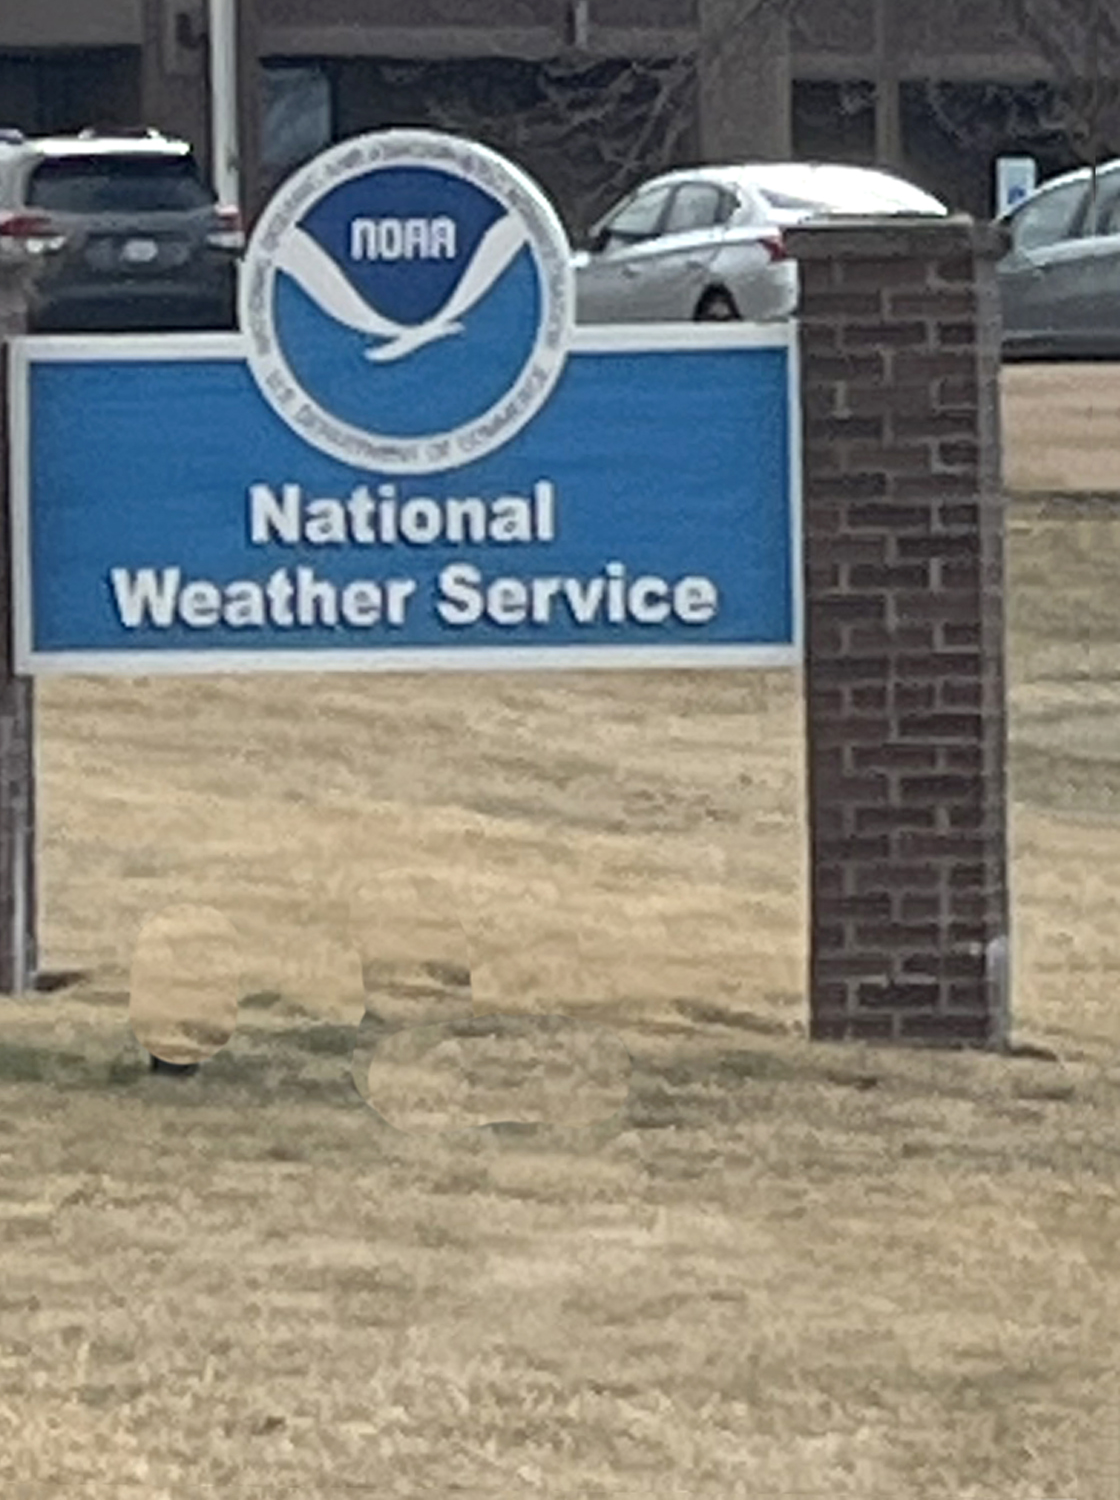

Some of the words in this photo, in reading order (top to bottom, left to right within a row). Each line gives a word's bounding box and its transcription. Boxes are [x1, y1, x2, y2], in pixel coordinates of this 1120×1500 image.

[350, 216, 457, 260] NOAA
[249, 481, 555, 543] National
[110, 567, 416, 628] Weather
[438, 562, 717, 626] Service
